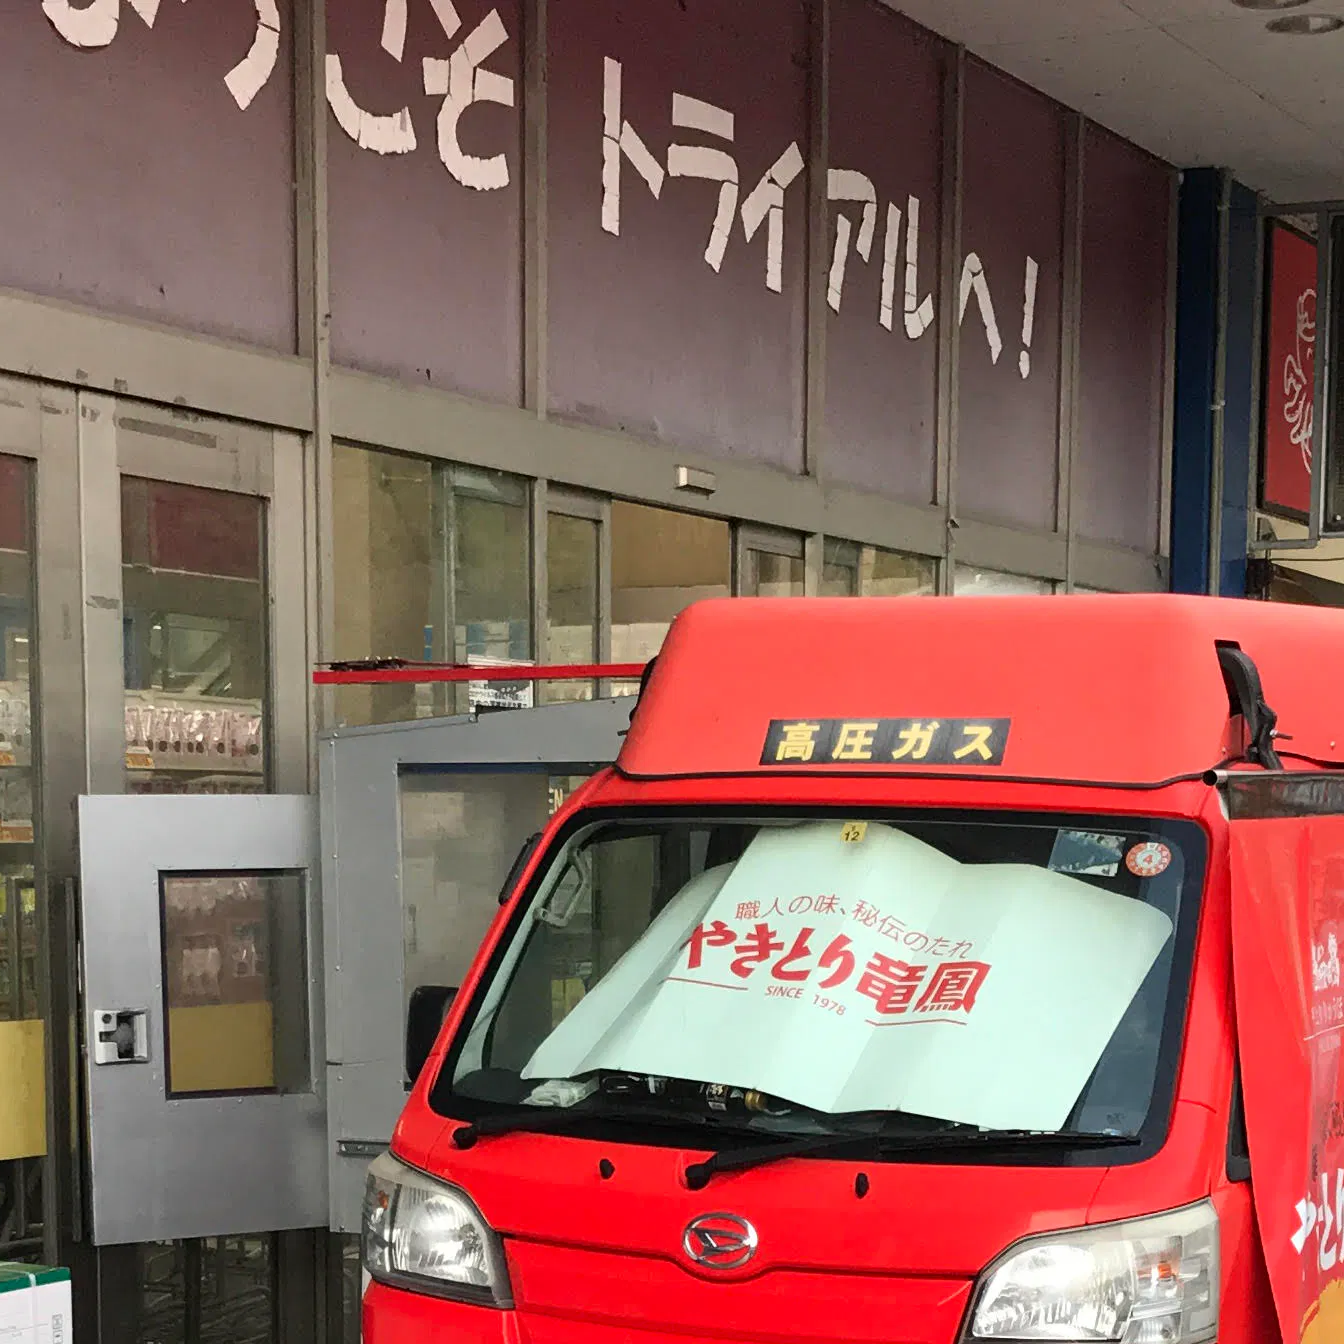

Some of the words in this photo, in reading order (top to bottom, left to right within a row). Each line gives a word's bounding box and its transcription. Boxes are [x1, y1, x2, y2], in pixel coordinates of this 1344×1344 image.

[774, 720, 997, 762] 高圧ガス
[844, 831, 860, 842] 12
[734, 893, 976, 960] 職人の味、秘伝のたれ
[764, 985, 805, 1000] SINCE
[811, 993, 847, 1016] 1978
